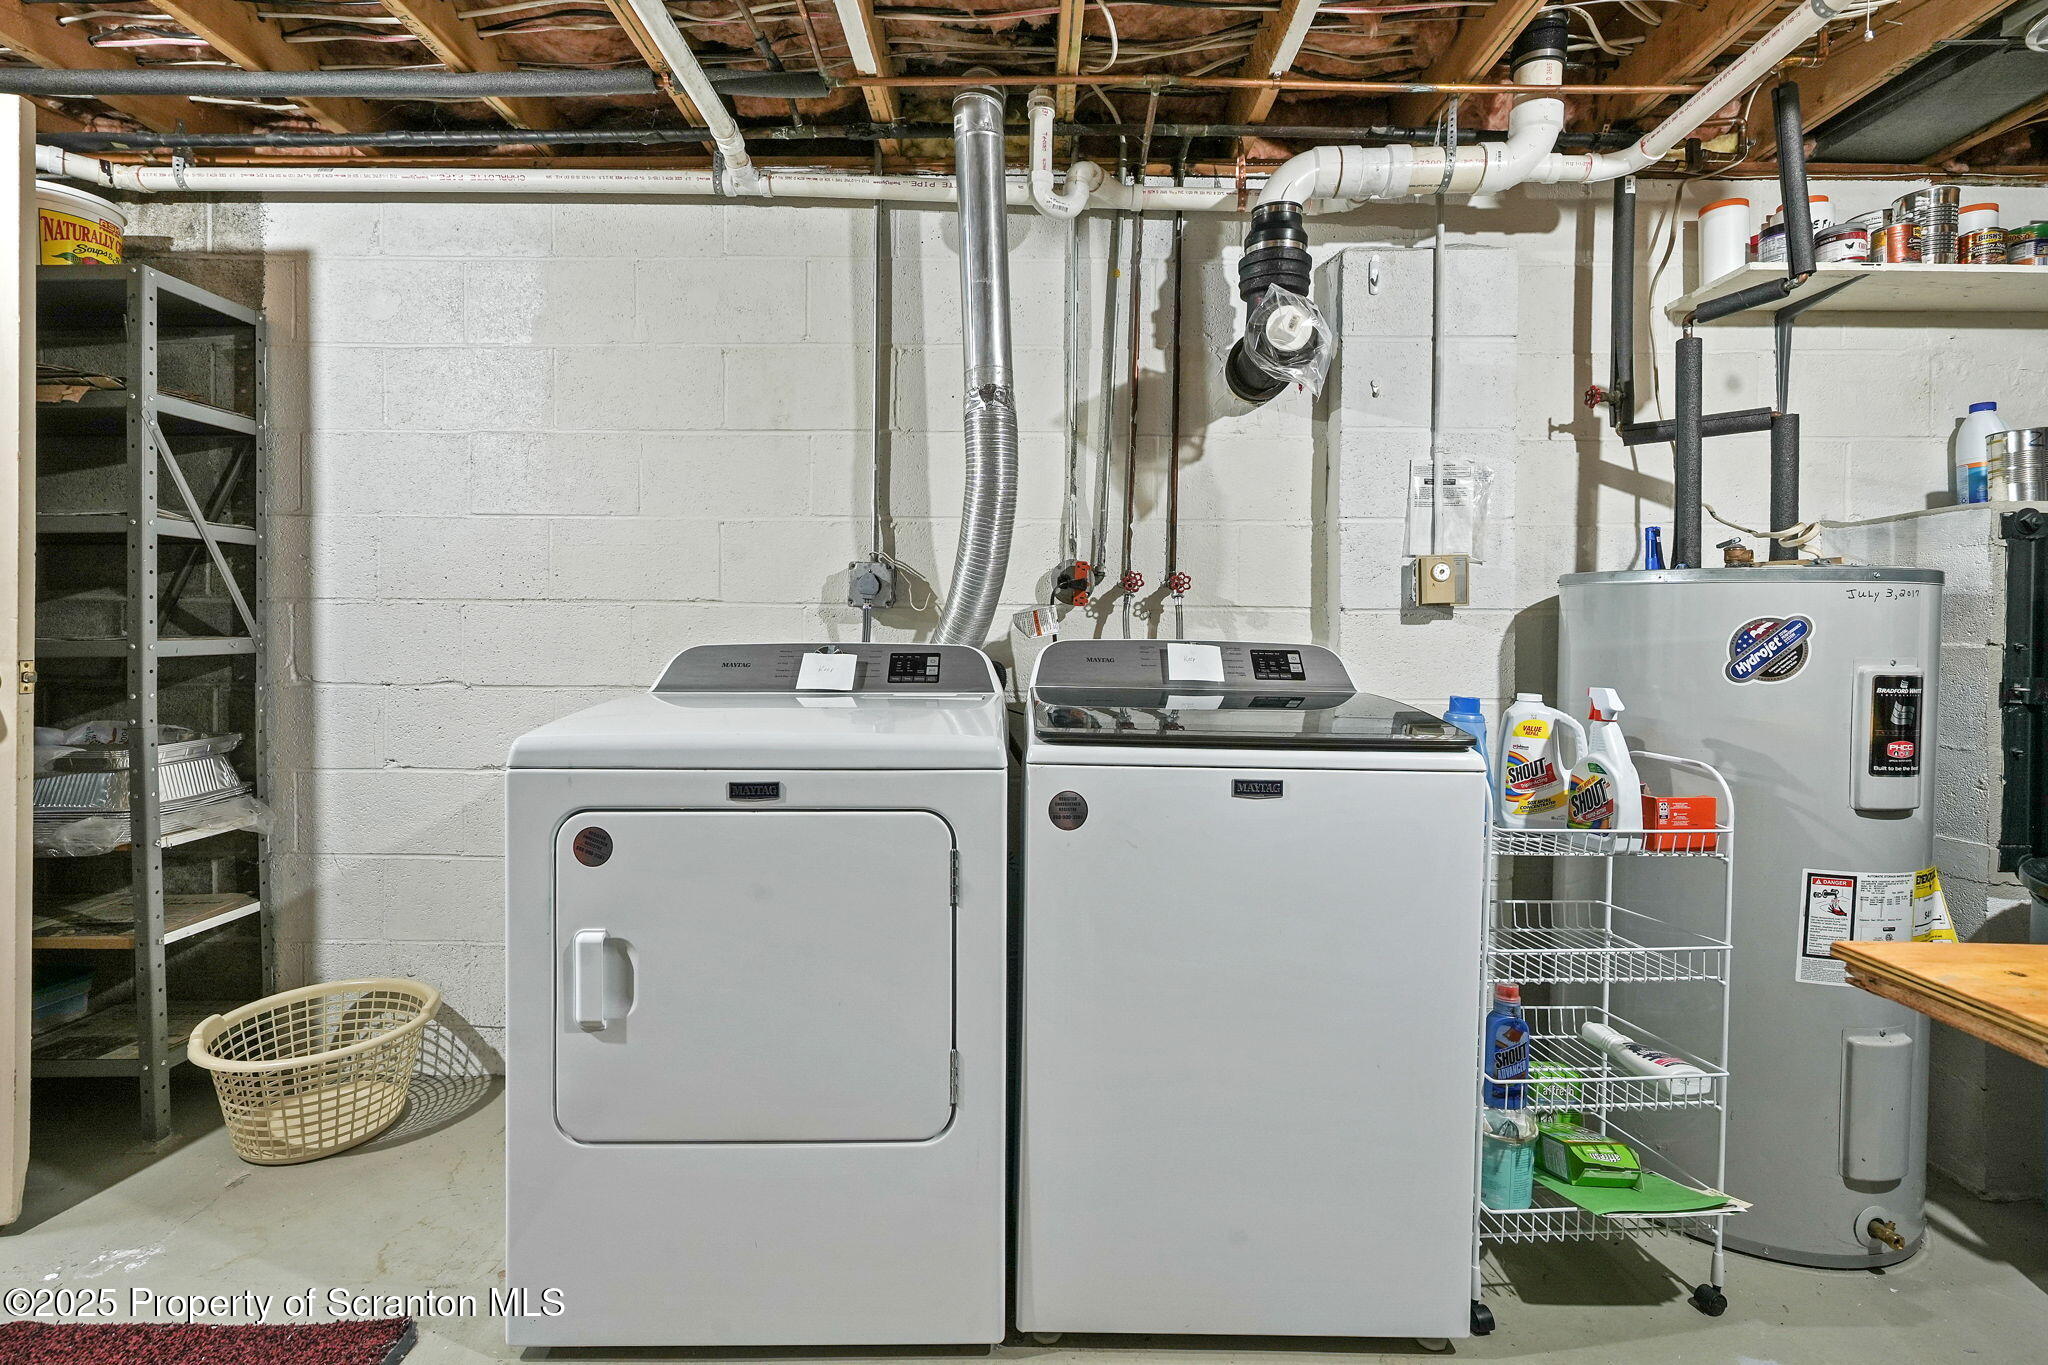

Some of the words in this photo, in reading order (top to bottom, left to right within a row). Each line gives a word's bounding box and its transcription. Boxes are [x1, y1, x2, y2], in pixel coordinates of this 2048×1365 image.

[469, 174, 526, 183] CHARLOTTE
[911, 181, 936, 189] PIPE
[40, 216, 115, 250] NATURALLY
[72, 244, 108, 257] Soups
[1734, 635, 1783, 676] Hydrojet
[1523, 725, 1543, 733] VALUE
[1507, 757, 1546, 784] SHOUT
[731, 785, 777, 796] MAYTAG
[1236, 783, 1281, 793] MAYTAG
[1570, 777, 1608, 818] SHOUT
[1822, 879, 1848, 887] DANGER
[1494, 1041, 1528, 1069] SHOUT
[1497, 1060, 1527, 1080] ADVANCED
[1589, 1152, 1622, 1163] affresh
